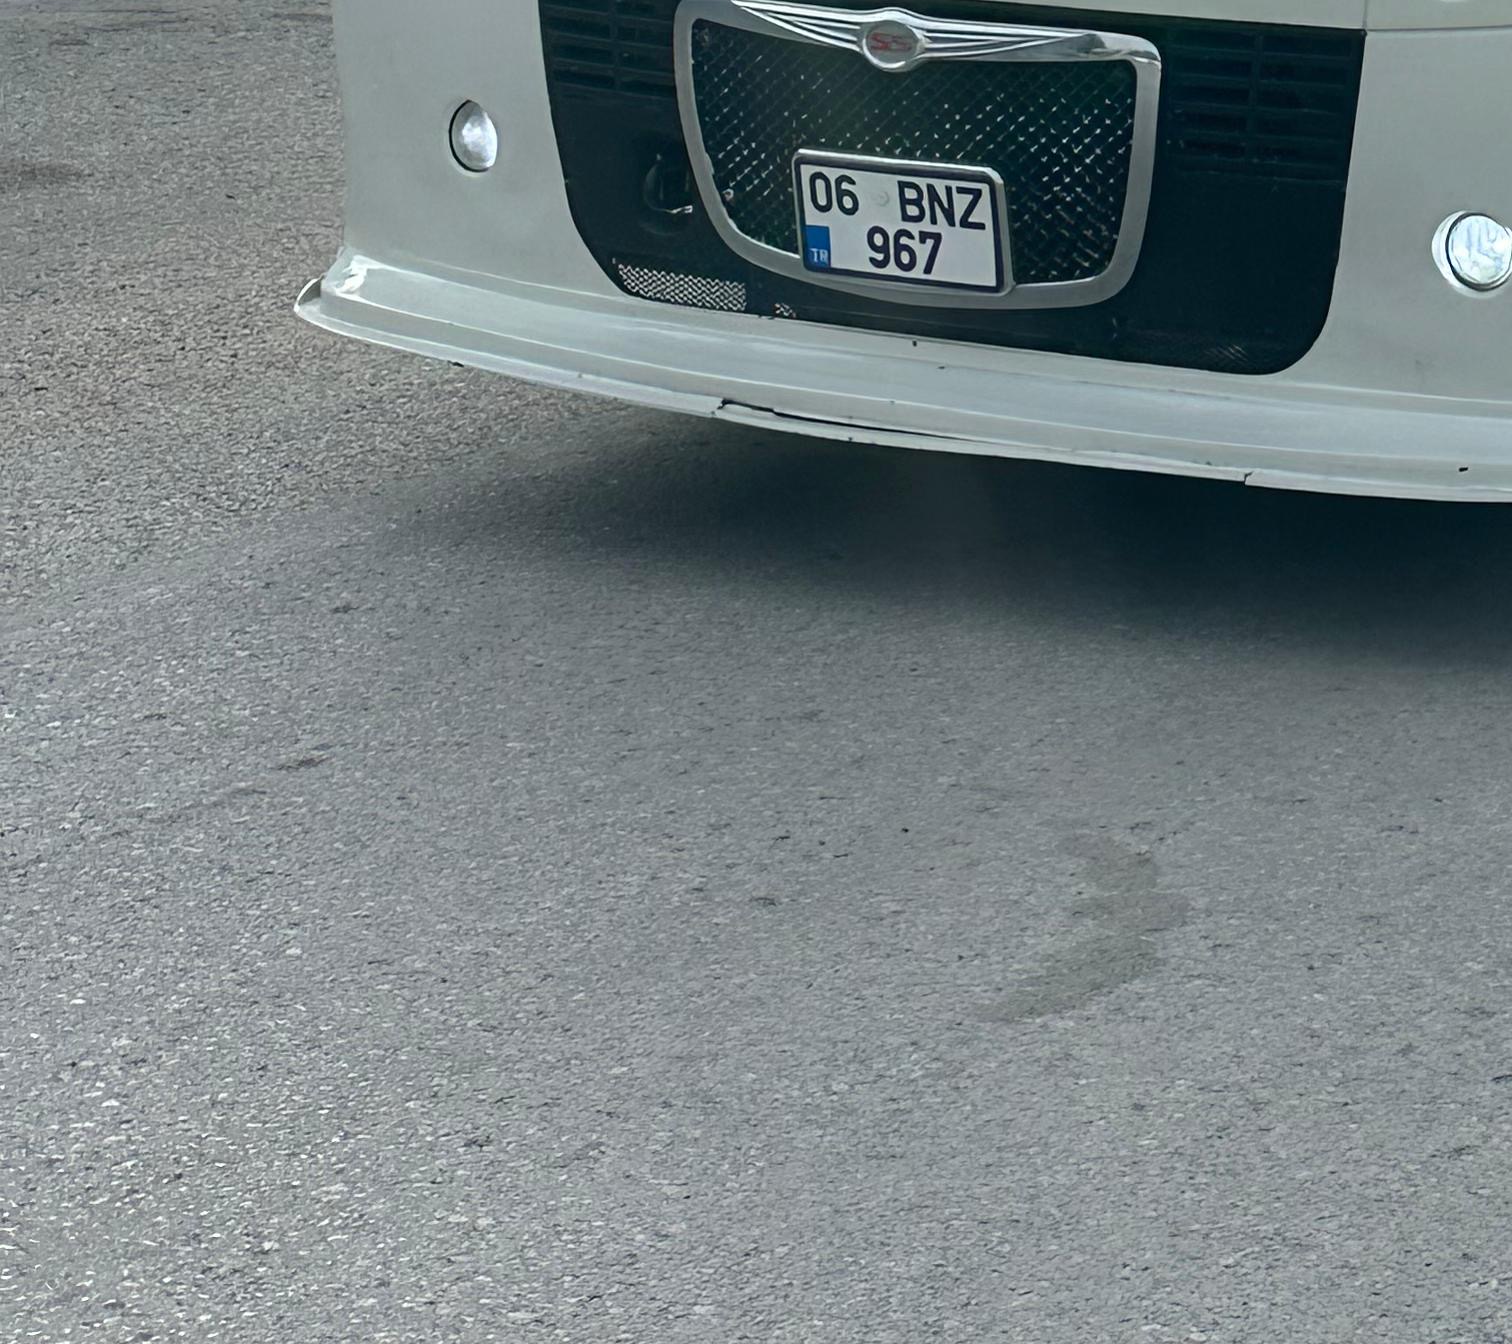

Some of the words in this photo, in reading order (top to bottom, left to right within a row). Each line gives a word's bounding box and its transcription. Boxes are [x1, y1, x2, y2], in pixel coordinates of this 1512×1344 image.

[809, 171, 860, 216] 06
[897, 180, 986, 231] BNZ
[810, 247, 828, 263] TR
[866, 225, 943, 275] 967
